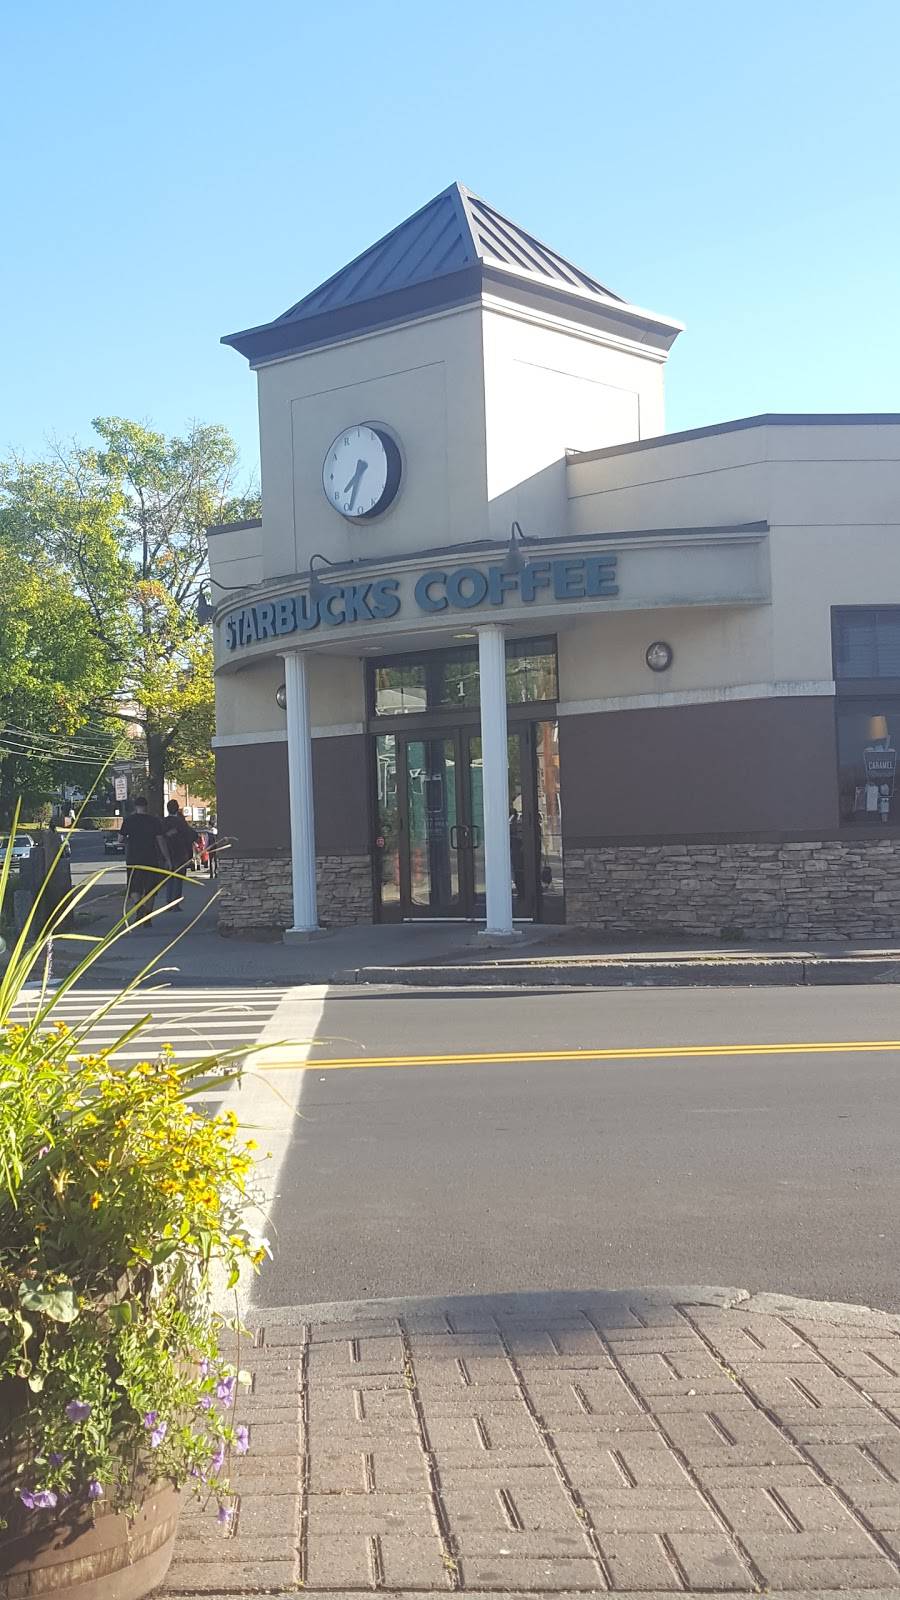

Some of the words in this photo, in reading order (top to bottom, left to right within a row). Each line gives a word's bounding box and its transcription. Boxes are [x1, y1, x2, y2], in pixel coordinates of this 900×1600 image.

[222, 578, 401, 650] STARBUCKS
[414, 555, 620, 613] COFFEE
[457, 681, 466, 697] 1
[868, 760, 894, 770] CARAMEL
